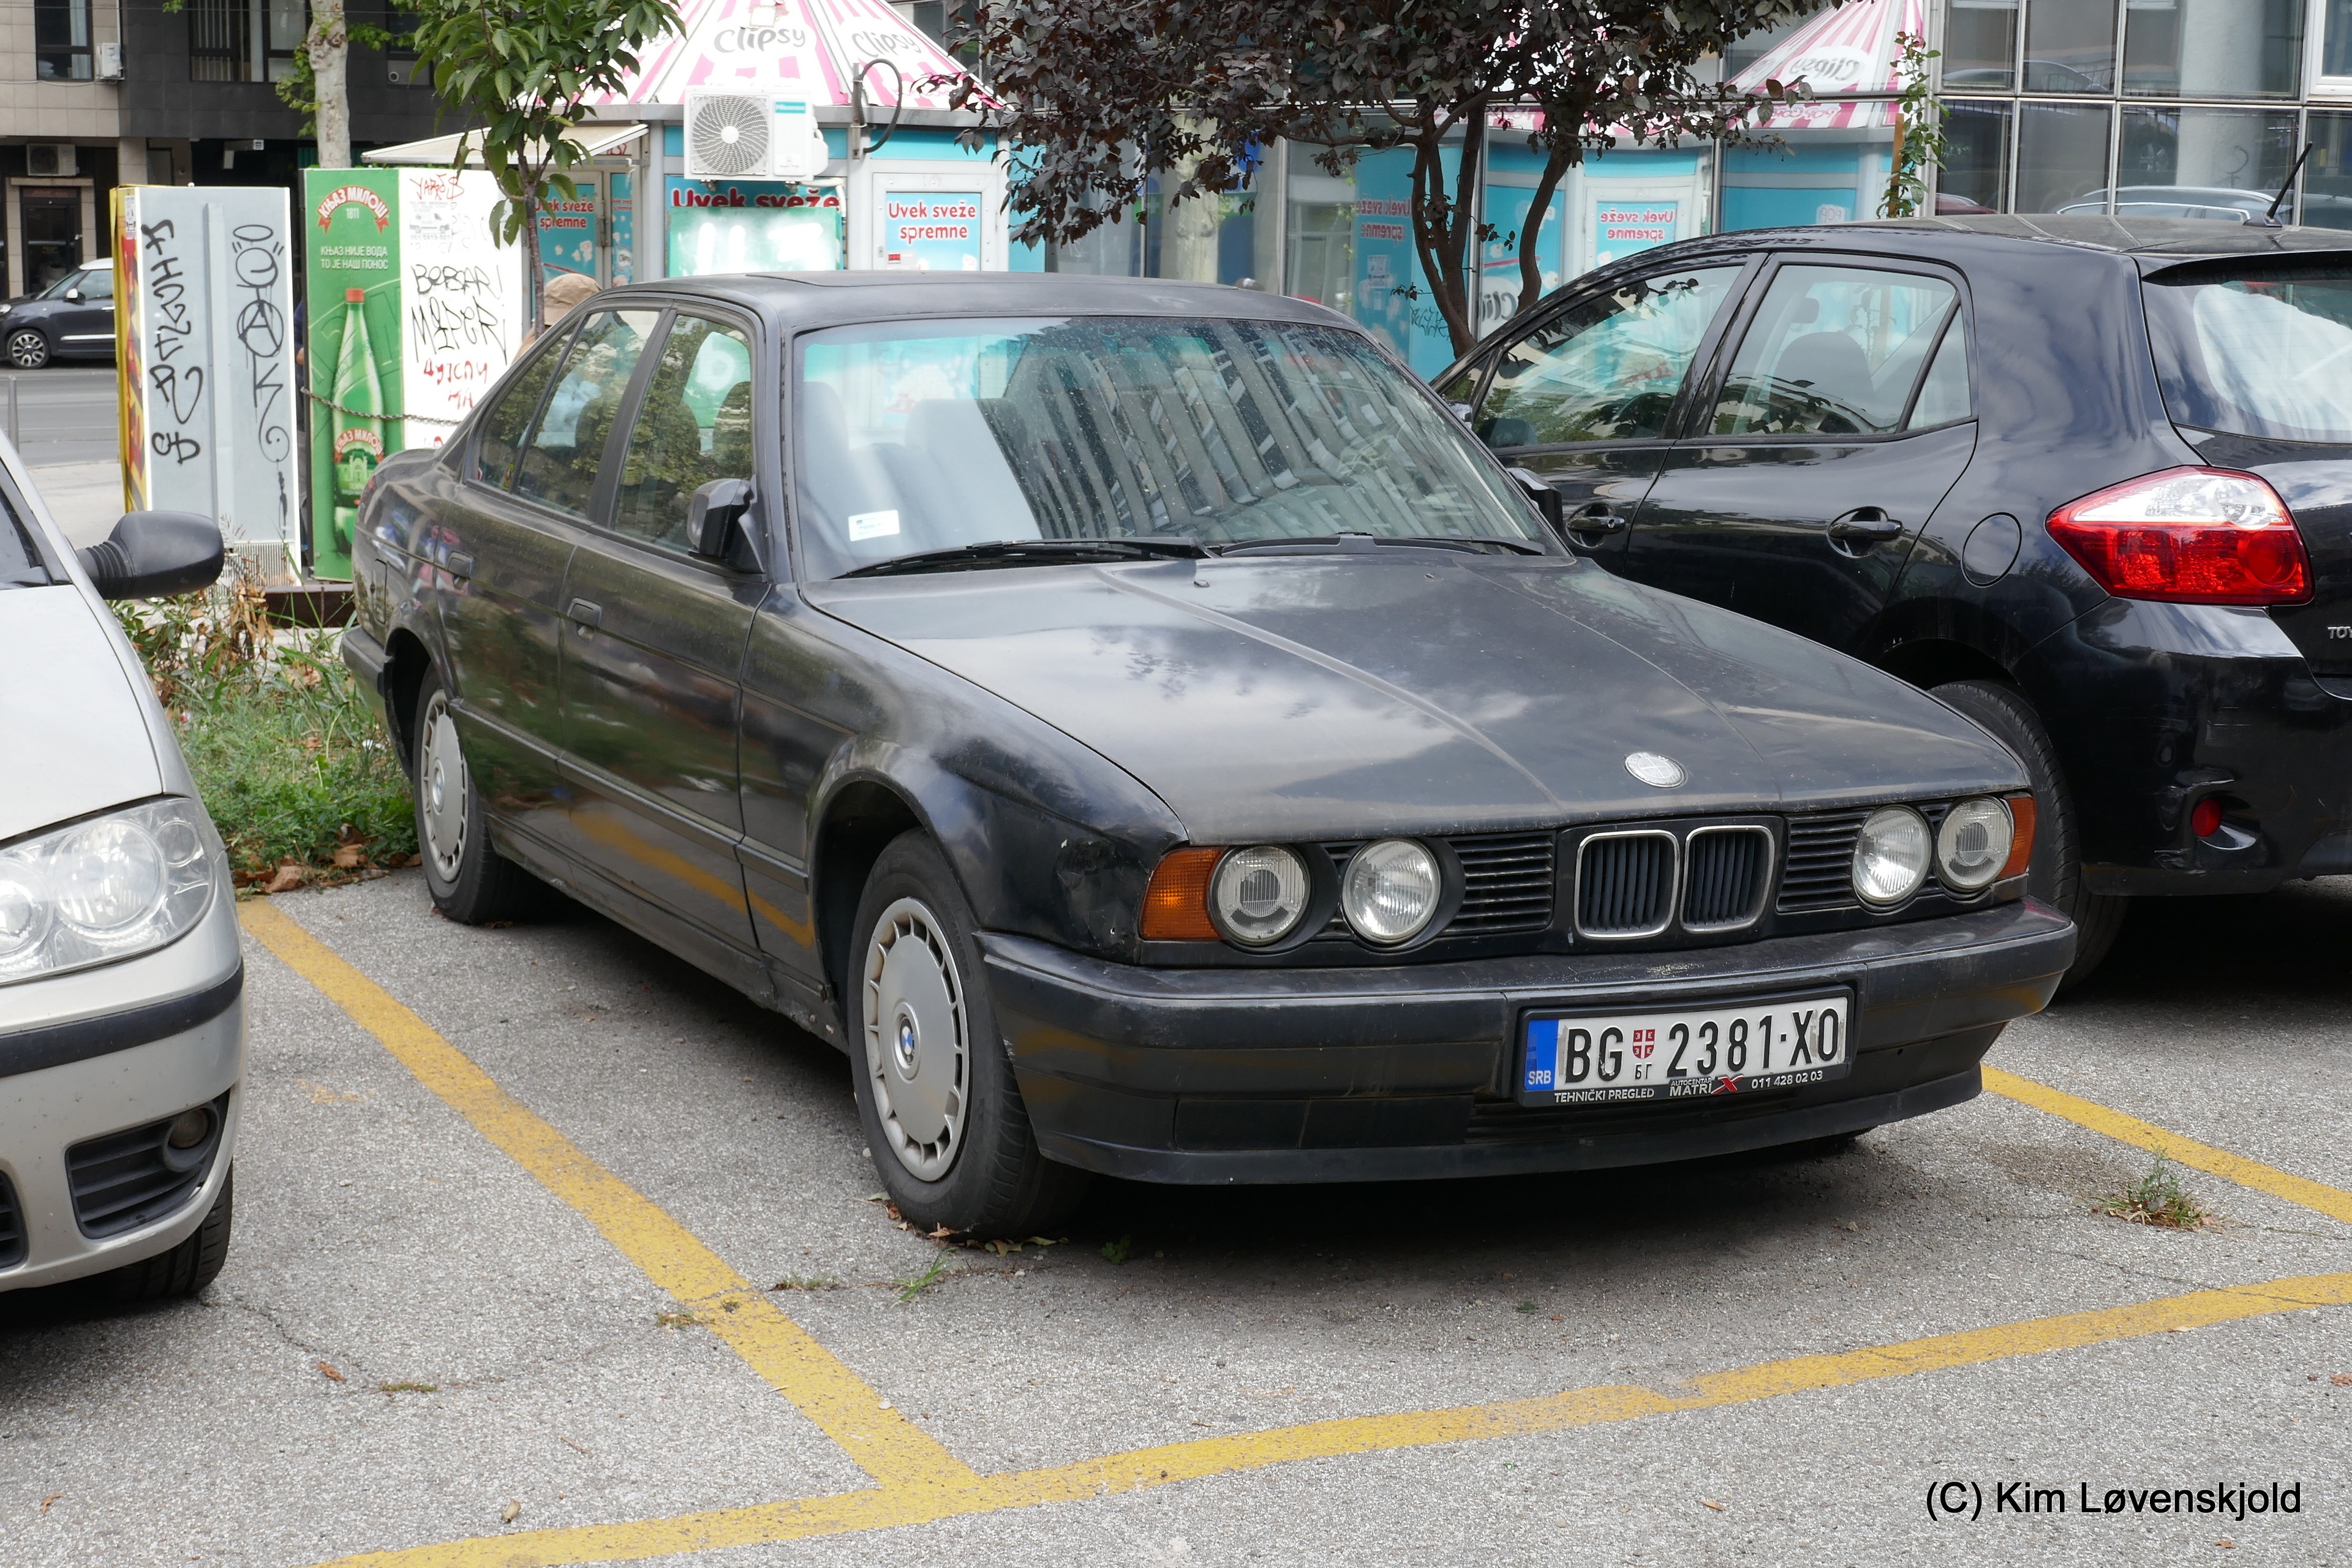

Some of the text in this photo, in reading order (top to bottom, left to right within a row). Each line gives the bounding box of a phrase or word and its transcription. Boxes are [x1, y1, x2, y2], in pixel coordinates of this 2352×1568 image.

[714, 26, 805, 53] Clipsy
[852, 32, 922, 58] Clipsy
[318, 189, 346, 218] КЊАЗ
[347, 186, 388, 218] МИЛОШ
[562, 198, 594, 212] sveže
[889, 202, 976, 218] Uvek sveže
[900, 226, 968, 244] spremne
[320, 246, 388, 258] КЊАЗ НИЈЕ ВОДА
[320, 259, 388, 270] ТО ЈЕ НАШ ПОНОС
[1565, 1026, 1624, 1084] BG
[1528, 1070, 1551, 1085] SRB
[1670, 1078, 1713, 1087] AUTOCENTAR
[1751, 1071, 1823, 1090] 011 428 02 03
[1554, 1088, 1654, 1103] TEHNIČKI PREGLED
